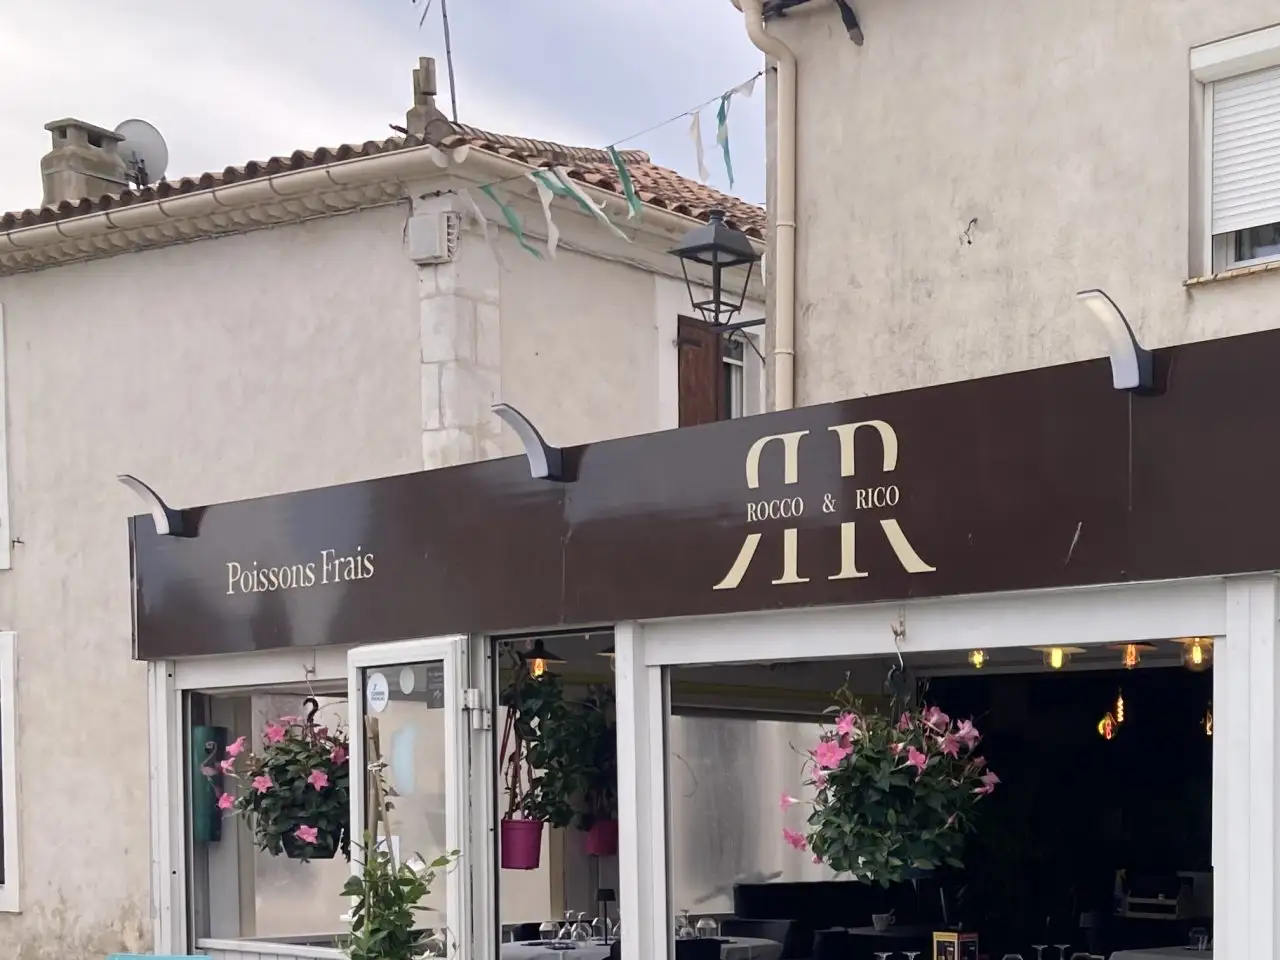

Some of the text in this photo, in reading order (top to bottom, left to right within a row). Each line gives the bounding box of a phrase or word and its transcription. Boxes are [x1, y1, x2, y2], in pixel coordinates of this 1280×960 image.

[746, 485, 900, 522] ROCCO & RICO
[225, 545, 375, 595] Poissons Frais
